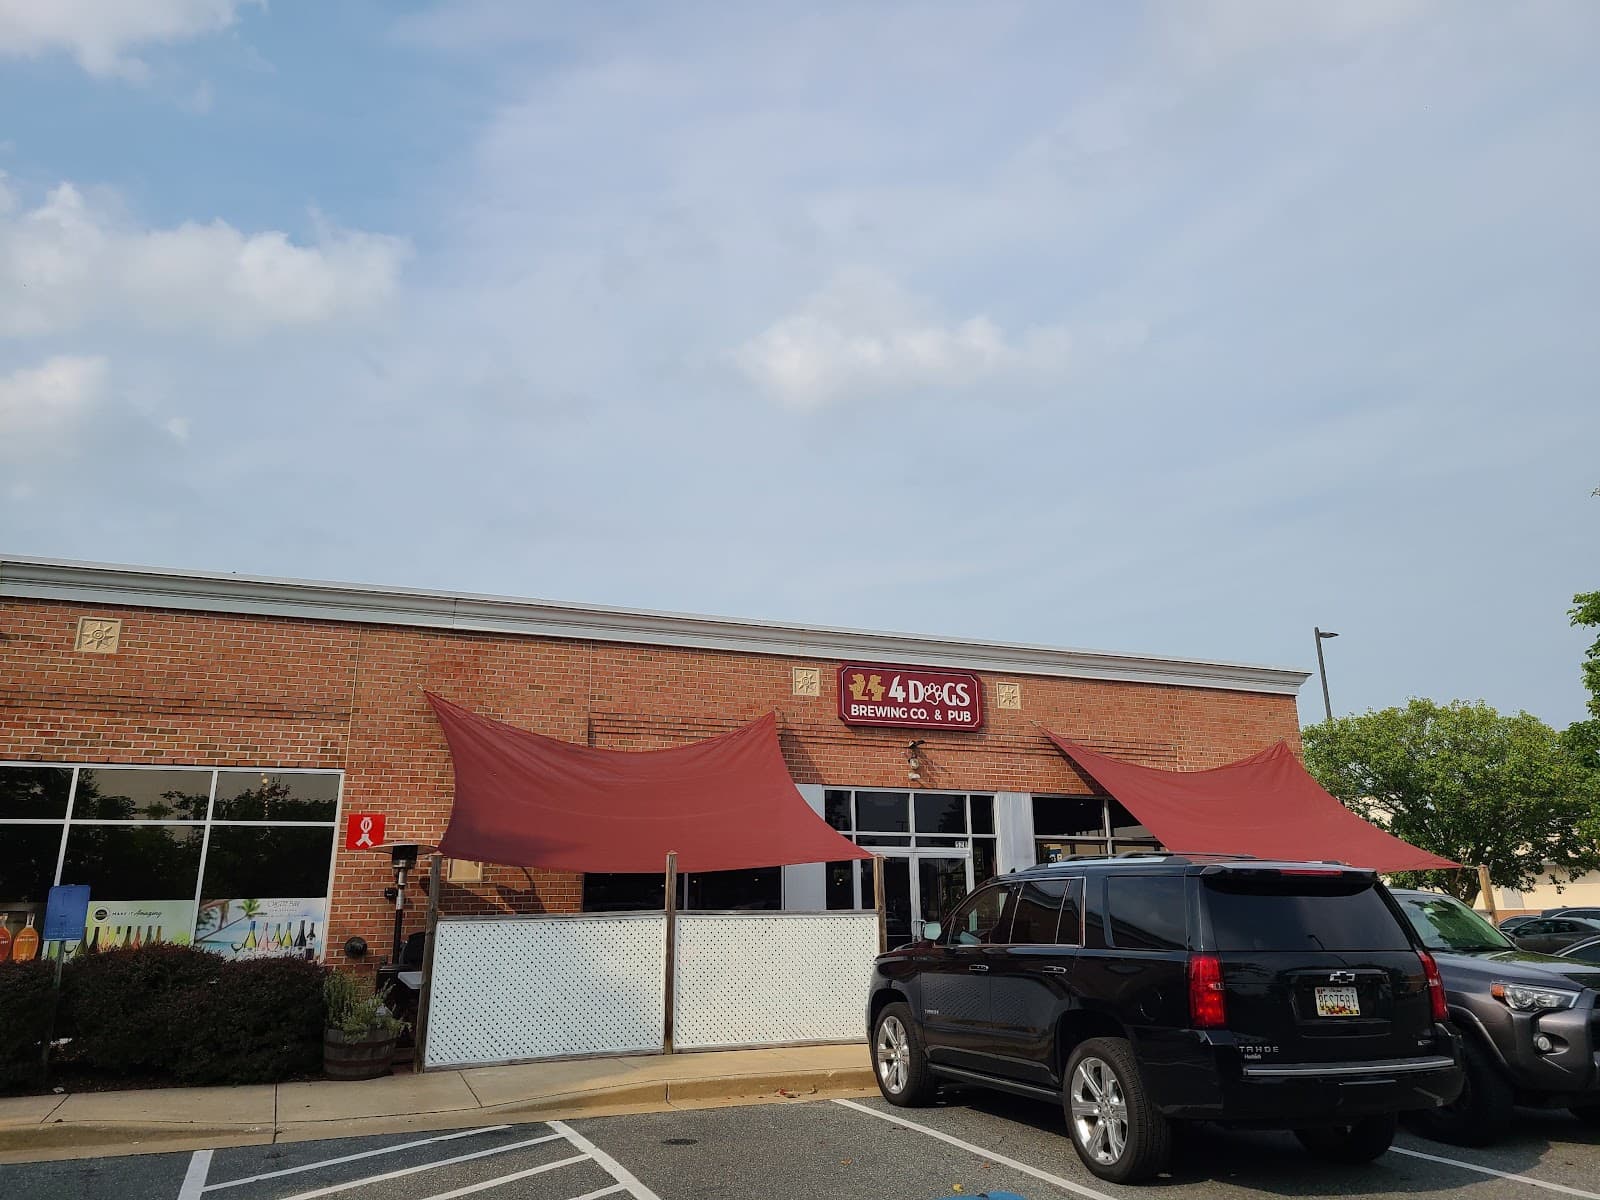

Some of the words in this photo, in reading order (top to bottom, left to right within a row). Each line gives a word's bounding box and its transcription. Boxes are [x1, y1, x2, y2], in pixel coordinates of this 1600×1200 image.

[888, 675, 906, 703] 4
[850, 704, 908, 719] BREWING
[910, 708, 930, 720] CO.
[934, 709, 942, 721] &
[947, 710, 972, 722] PUB
